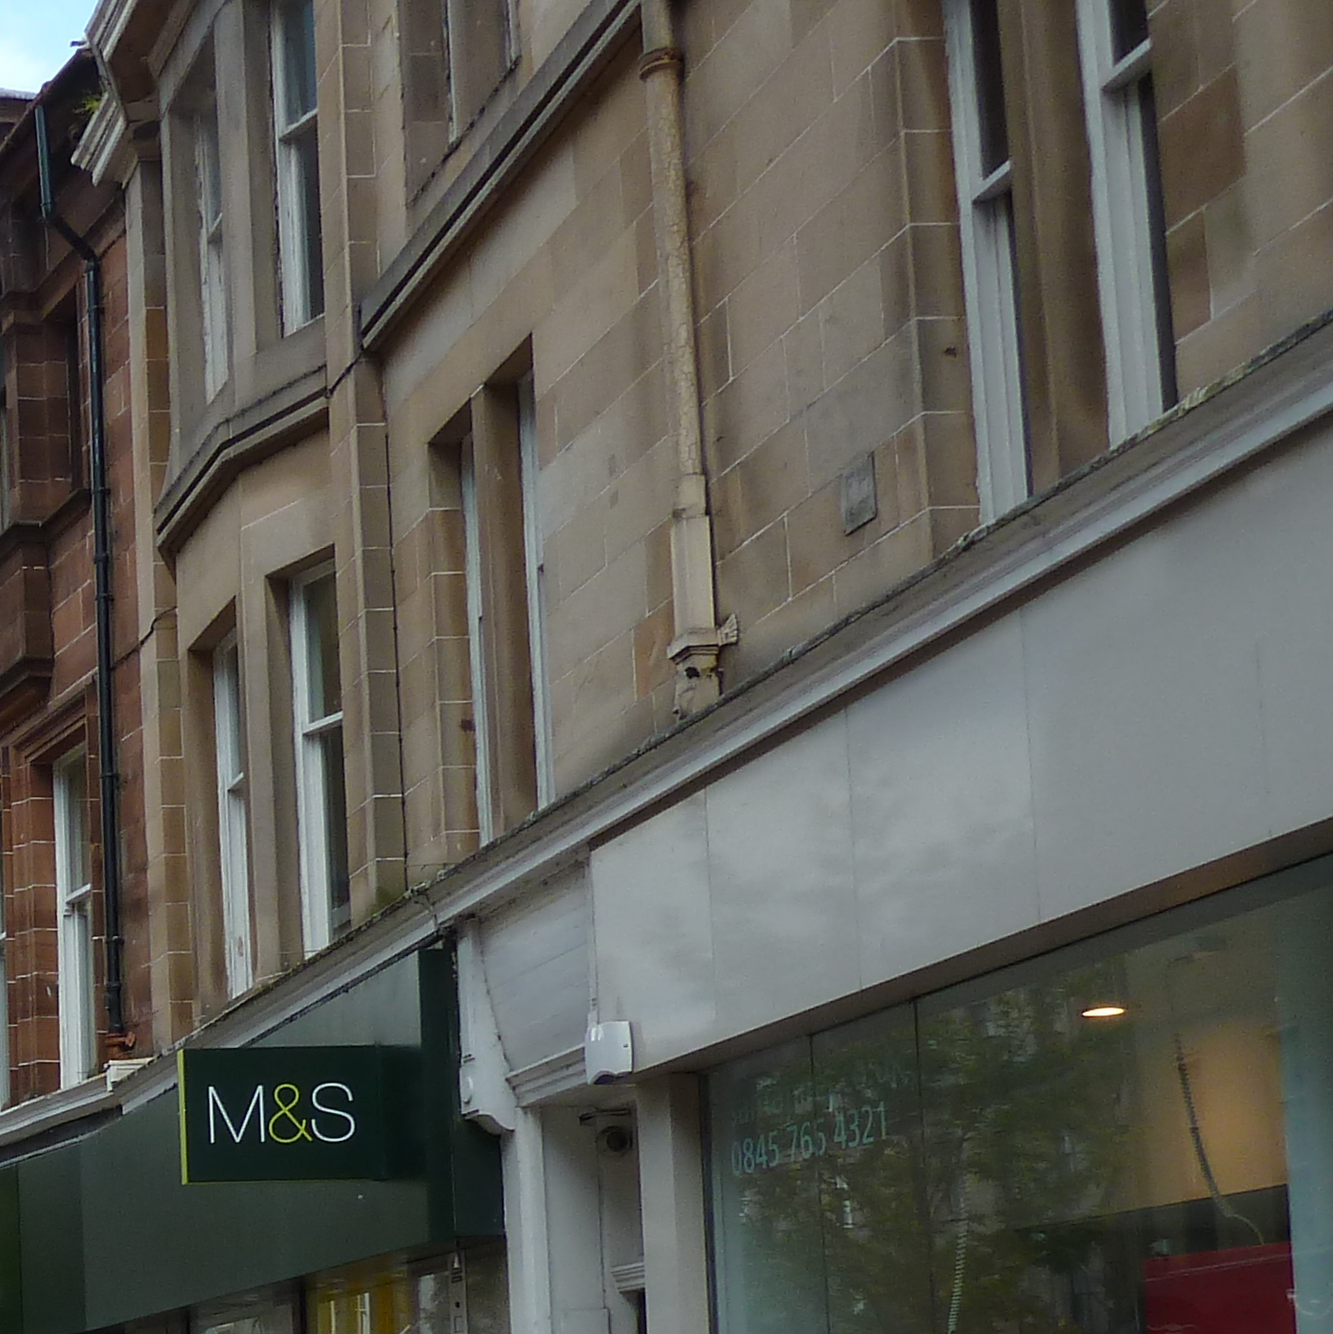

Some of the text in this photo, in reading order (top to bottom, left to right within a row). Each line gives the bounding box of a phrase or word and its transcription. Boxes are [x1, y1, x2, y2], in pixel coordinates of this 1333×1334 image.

[207, 1082, 356, 1144] M&S
[731, 1100, 887, 1176] 0845 765 4321
